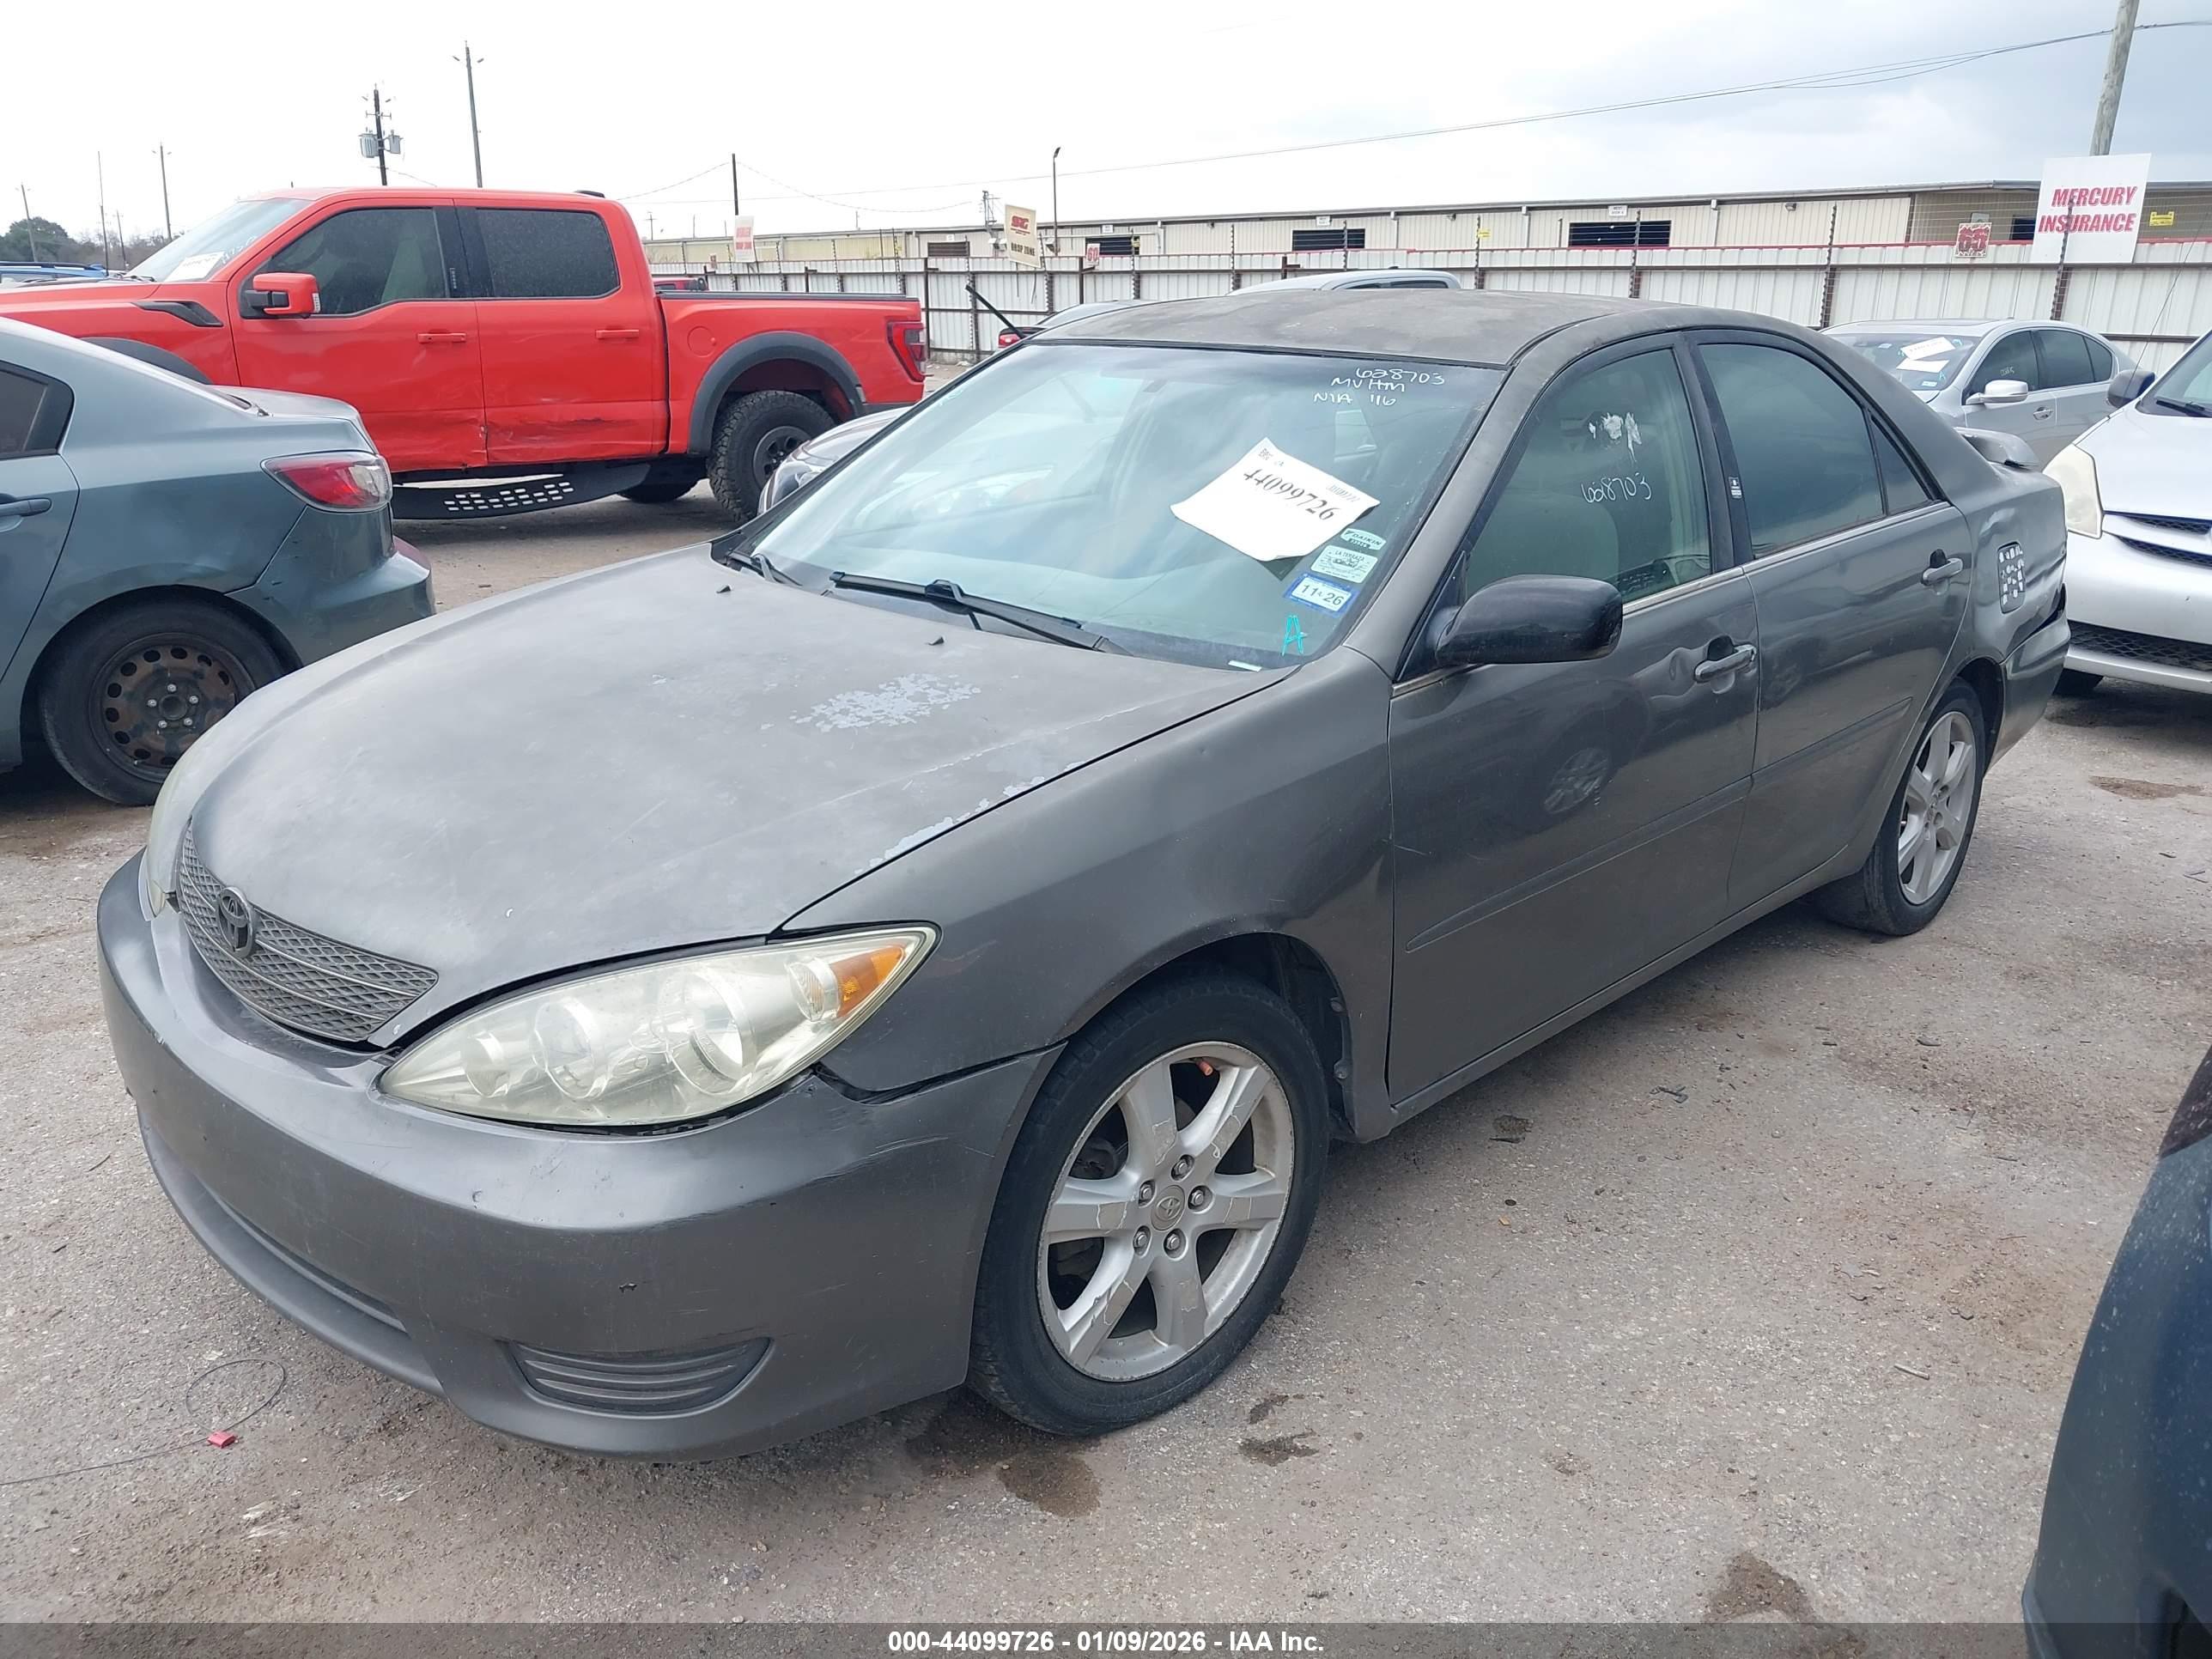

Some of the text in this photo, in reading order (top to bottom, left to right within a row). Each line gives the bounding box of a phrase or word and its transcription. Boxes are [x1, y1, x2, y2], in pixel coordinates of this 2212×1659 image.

[2051, 185, 2138, 207] MERCURY
[2038, 213, 2138, 234] INSURANCE
[1356, 368, 1445, 386] 628703
[1243, 469, 1341, 520] 44099726
[1352, 533, 1382, 545] DAIKIN
[1301, 585, 1345, 605] 11 26
